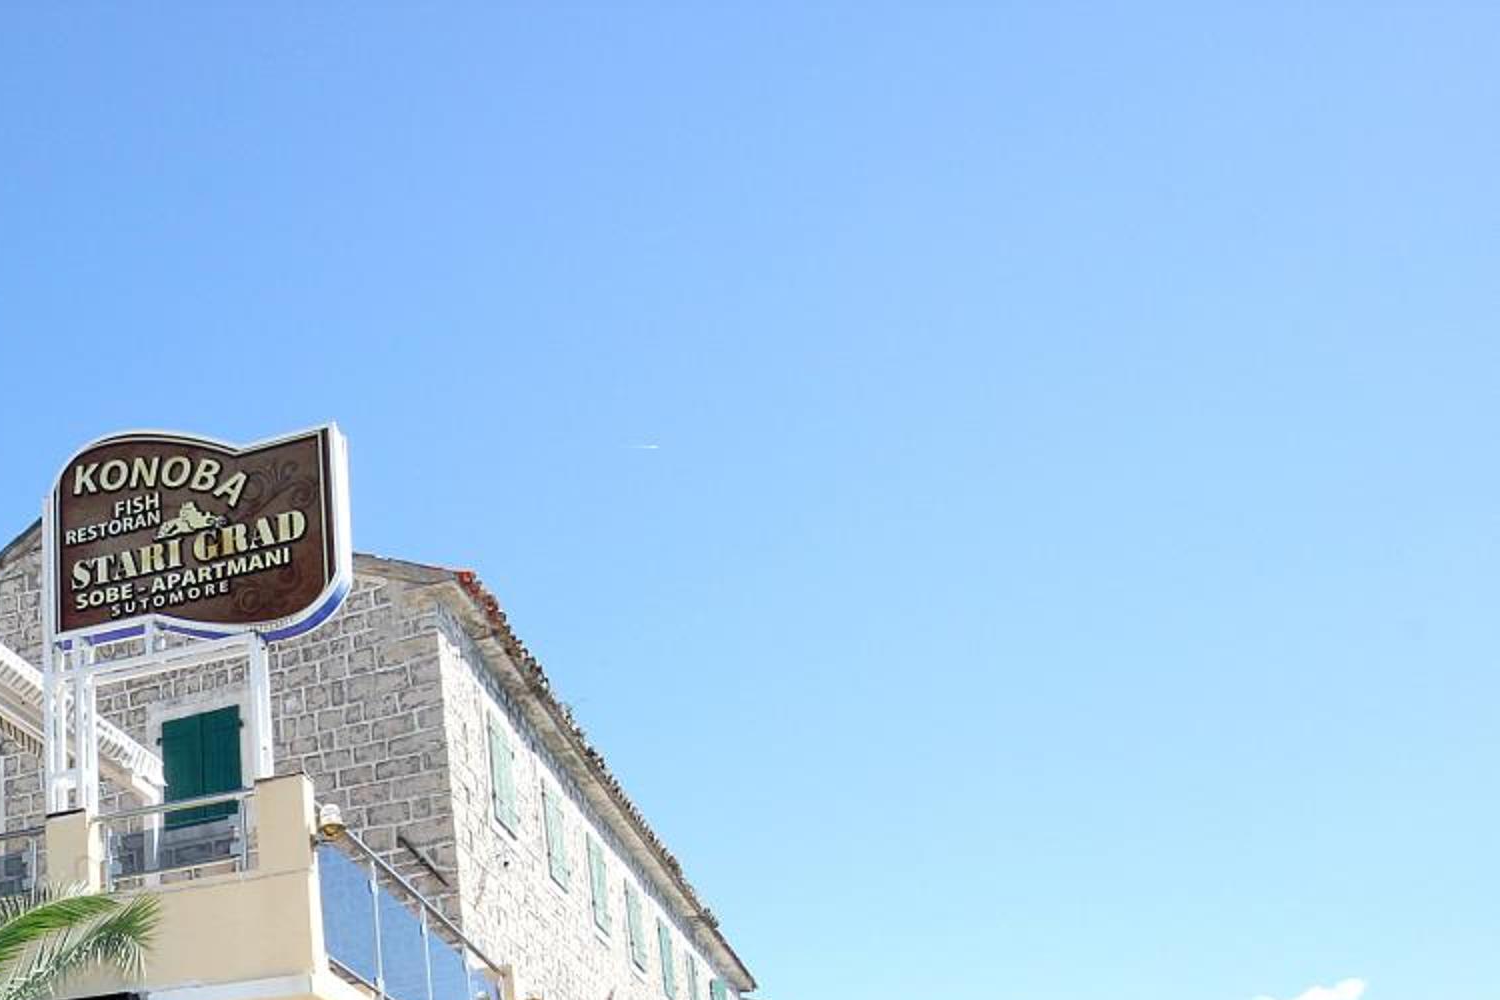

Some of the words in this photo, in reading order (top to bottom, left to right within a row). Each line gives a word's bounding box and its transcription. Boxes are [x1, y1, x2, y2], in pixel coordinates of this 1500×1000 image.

[73, 456, 247, 507] KONOBA
[65, 510, 161, 545] RESTORAN
[114, 492, 160, 519] FISH
[71, 538, 184, 590] STARI
[193, 510, 306, 562] GRAD
[75, 582, 133, 611] SOBE
[151, 548, 291, 594] APARTMANI
[111, 581, 230, 618] SUTOMORE
